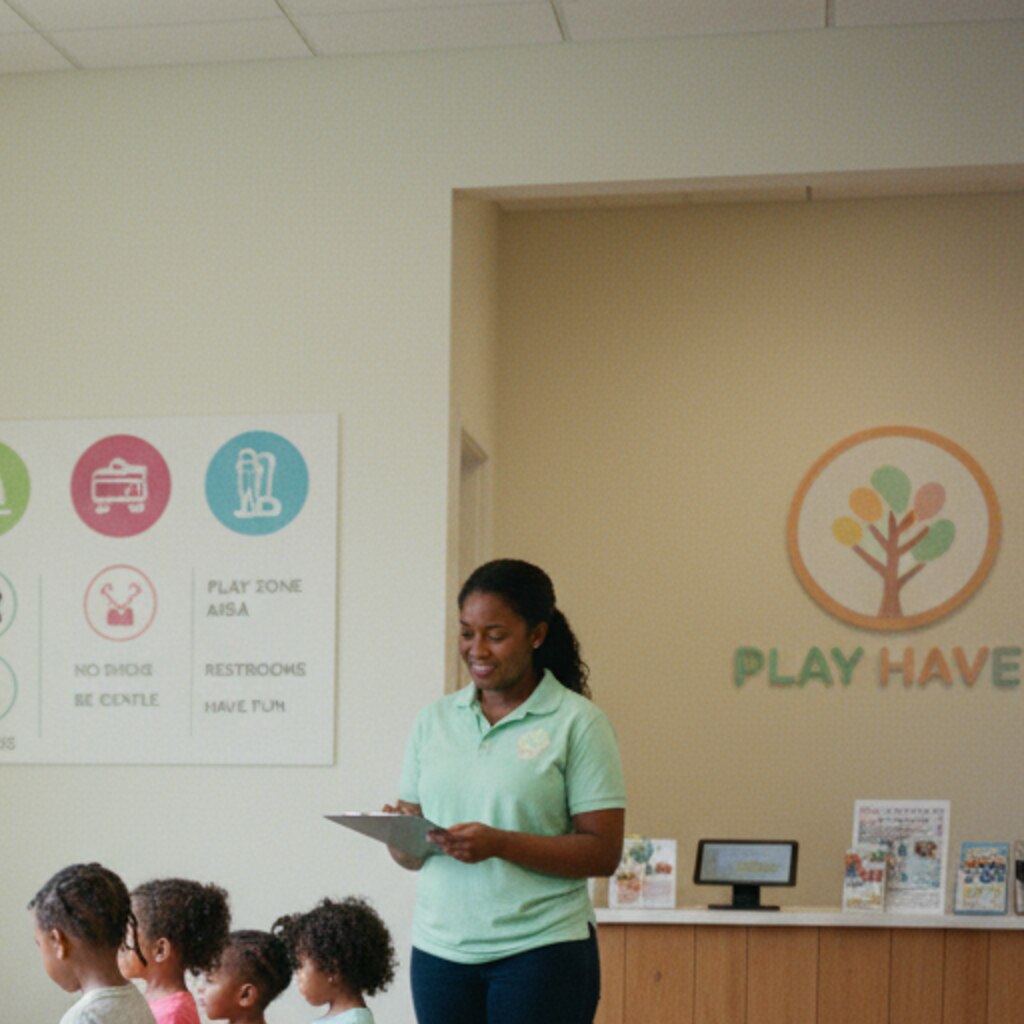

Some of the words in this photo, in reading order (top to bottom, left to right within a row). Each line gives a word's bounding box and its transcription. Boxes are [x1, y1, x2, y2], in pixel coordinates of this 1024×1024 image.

[207, 579, 250, 595] PLAY
[255, 578, 303, 594] ZONE
[74, 663, 101, 677] NO
[205, 662, 307, 677] RESTROOMS
[734, 646, 864, 688] PLAY
[879, 646, 1022, 688] HAVE
